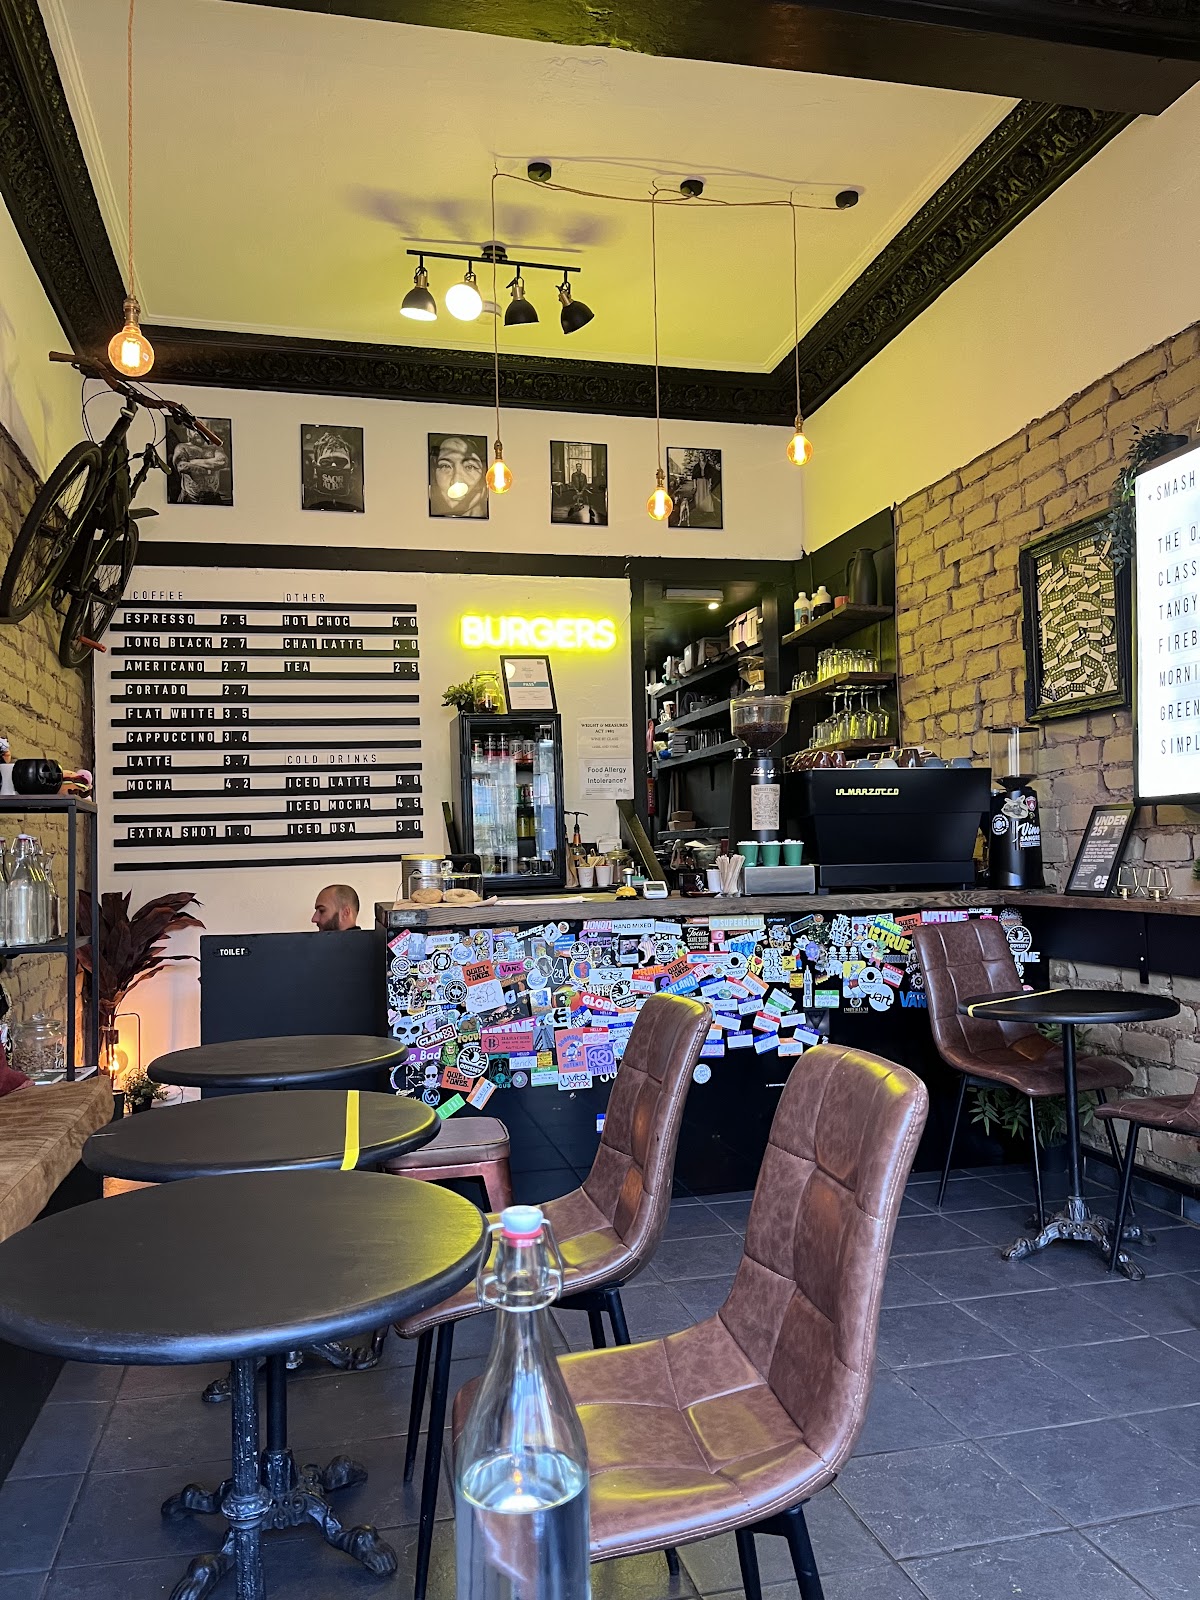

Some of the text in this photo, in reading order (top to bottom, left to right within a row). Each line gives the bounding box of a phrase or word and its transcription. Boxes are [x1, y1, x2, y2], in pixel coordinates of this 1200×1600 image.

[1157, 470, 1194, 500] SMASH
[1158, 532, 1178, 553] THE
[1158, 560, 1197, 586] CLASS
[133, 590, 184, 600] COFFEE
[286, 593, 326, 602] OTHER
[1159, 594, 1198, 620] TANGY
[126, 614, 246, 626] ESPRESSO 2.5
[284, 616, 416, 628] HOT CHOC 4.0
[461, 615, 617, 649] BURGERS
[126, 637, 246, 648] LONG BLACK 2.7
[284, 638, 416, 650] CHAI LATTE 4.0
[126, 660, 246, 672] AMERICANO 2.7
[286, 662, 416, 672] TEA 2.5
[127, 684, 247, 695] CORTADO 2.7
[128, 708, 248, 719] FLAT WHITE 3.5
[128, 732, 248, 742] CAPPUCCINO 3.6
[128, 756, 248, 766] LATTE 3.7
[288, 754, 376, 764] COLD DRINKS
[128, 778, 249, 790] MOCHA 4.2
[289, 775, 419, 788] ICED LATTE 4.0
[289, 798, 419, 811] ICED MOCHA 4.5
[1094, 815, 1128, 826] UNDER
[130, 826, 250, 839] EXTRA SHOT 1.0
[290, 821, 419, 834] ICED USA 3.0
[1091, 826, 1108, 836] 25?
[1094, 876, 1109, 888] 25
[922, 911, 968, 922] NATIVE
[220, 948, 245, 956] TOILET
[502, 964, 521, 972] VANS
[900, 991, 927, 1007] VAN
[420, 1048, 441, 1060] Bad
